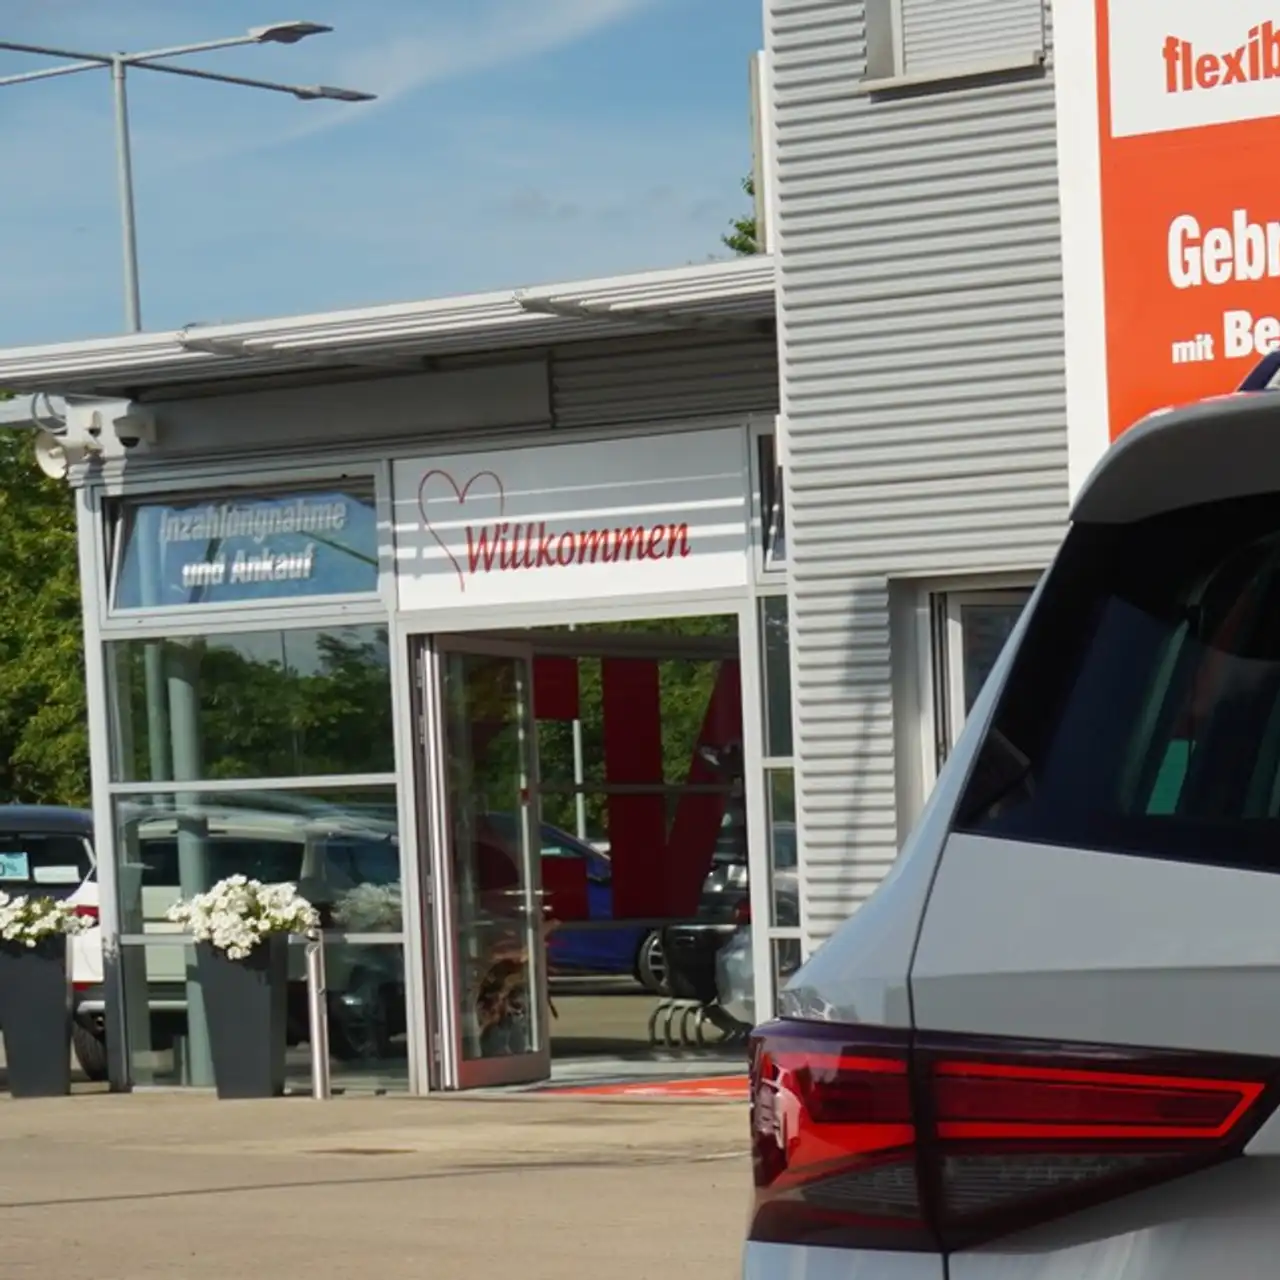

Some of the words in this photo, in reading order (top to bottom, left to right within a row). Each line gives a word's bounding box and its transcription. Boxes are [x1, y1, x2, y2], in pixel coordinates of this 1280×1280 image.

[1171, 333, 1215, 364] mit
[160, 501, 347, 544] Inzahlungnahme
[182, 551, 226, 587] und
[230, 543, 316, 584] Ankauf
[464, 520, 692, 574] Willkommen
